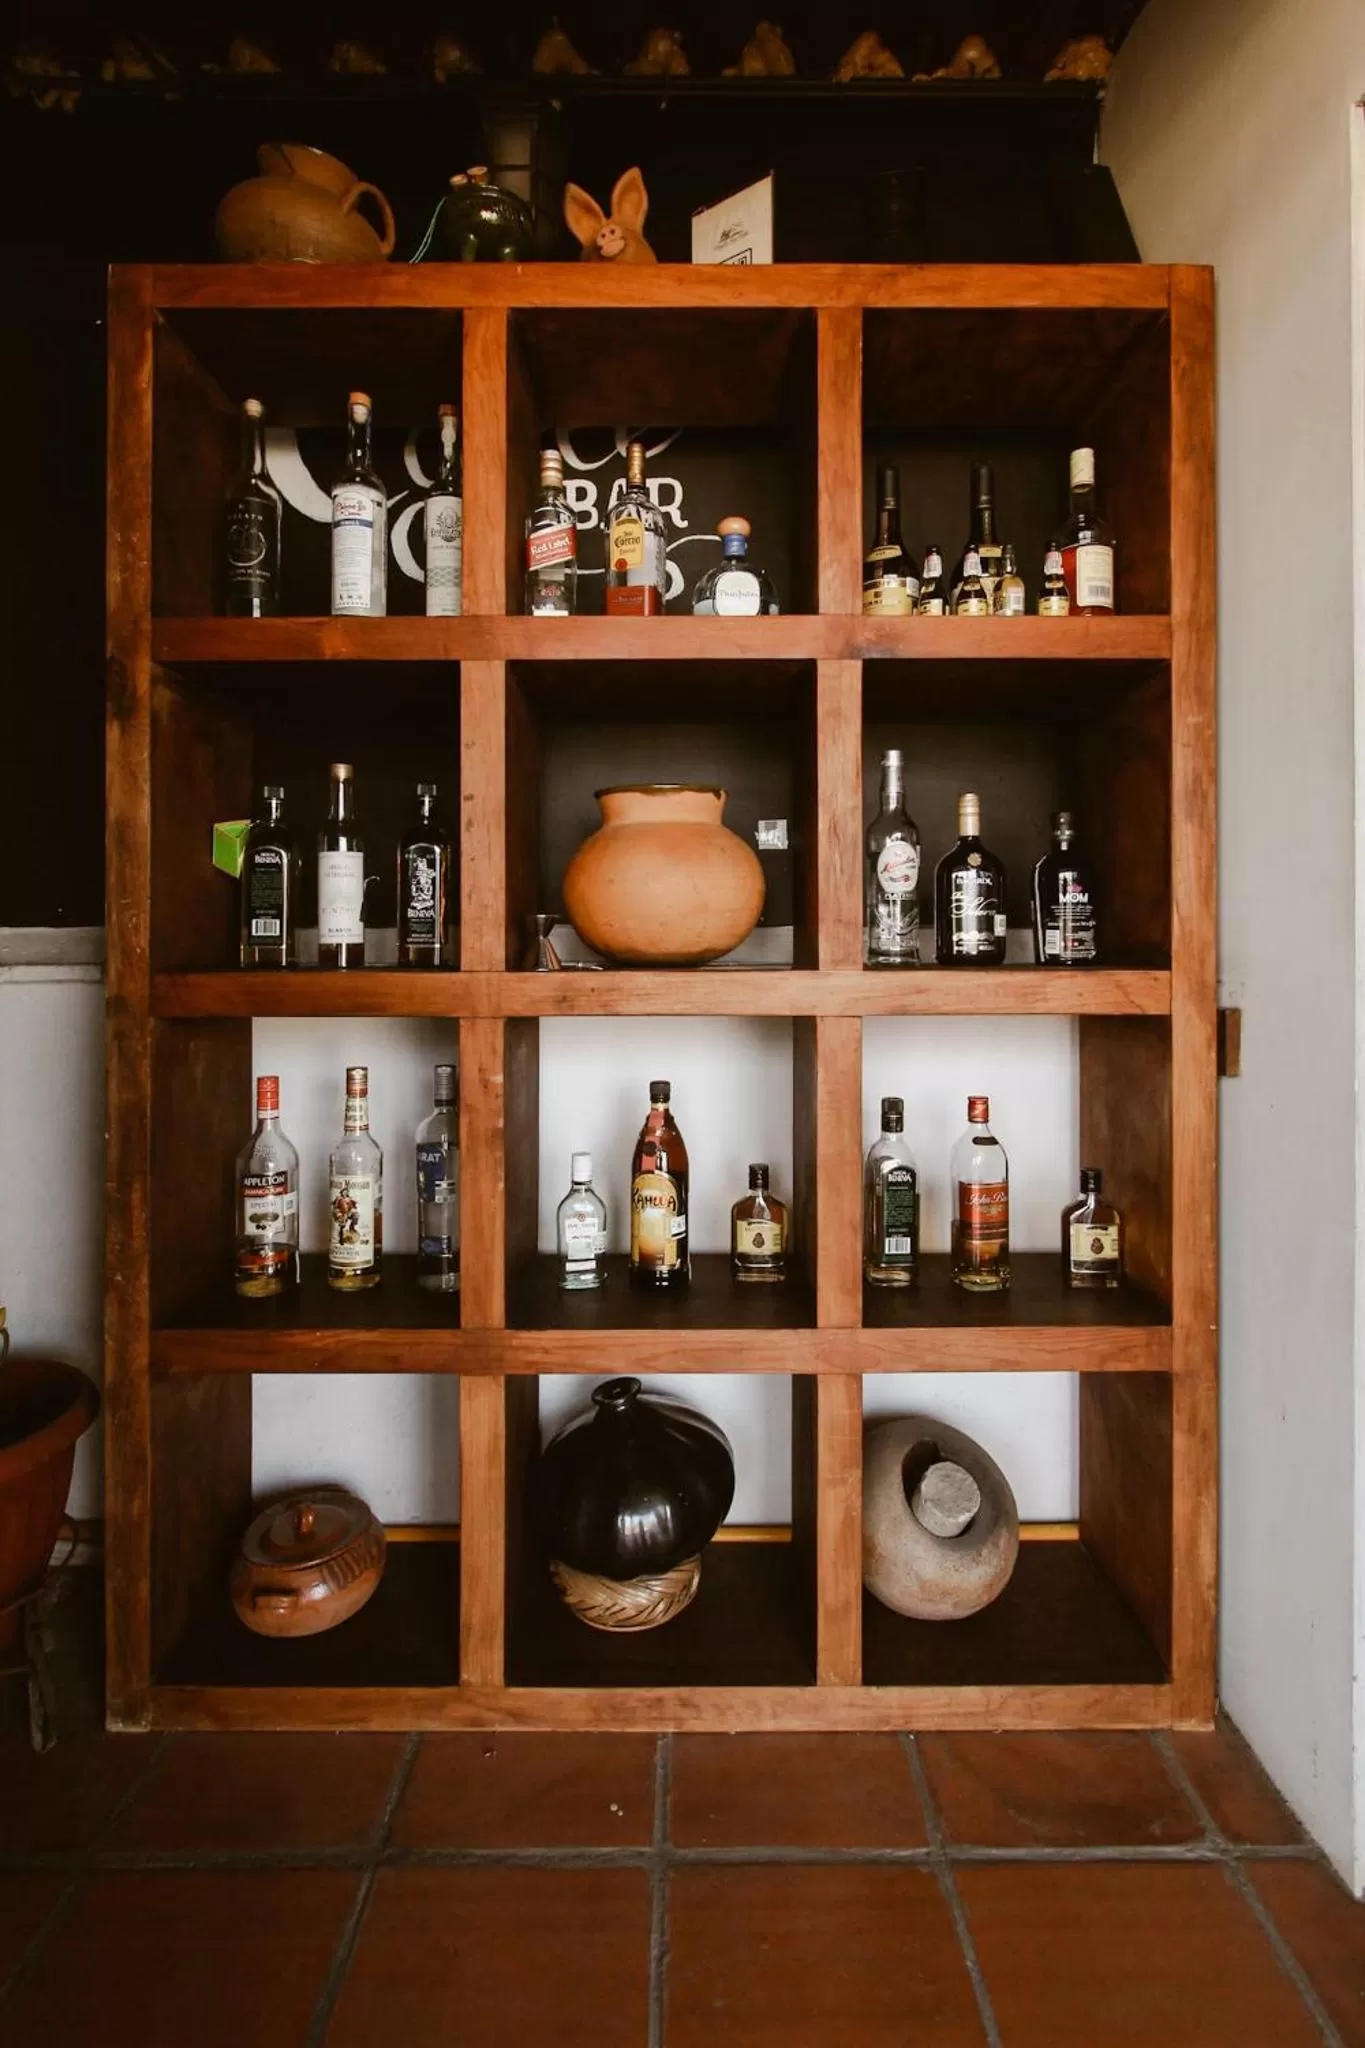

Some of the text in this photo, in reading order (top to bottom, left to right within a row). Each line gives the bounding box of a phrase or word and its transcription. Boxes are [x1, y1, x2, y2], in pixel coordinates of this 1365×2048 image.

[562, 477, 689, 530] BAR
[530, 543, 549, 557] Red
[548, 536, 570, 550] Label
[1059, 893, 1089, 903] MOM
[244, 1175, 285, 1187] APPLETON
